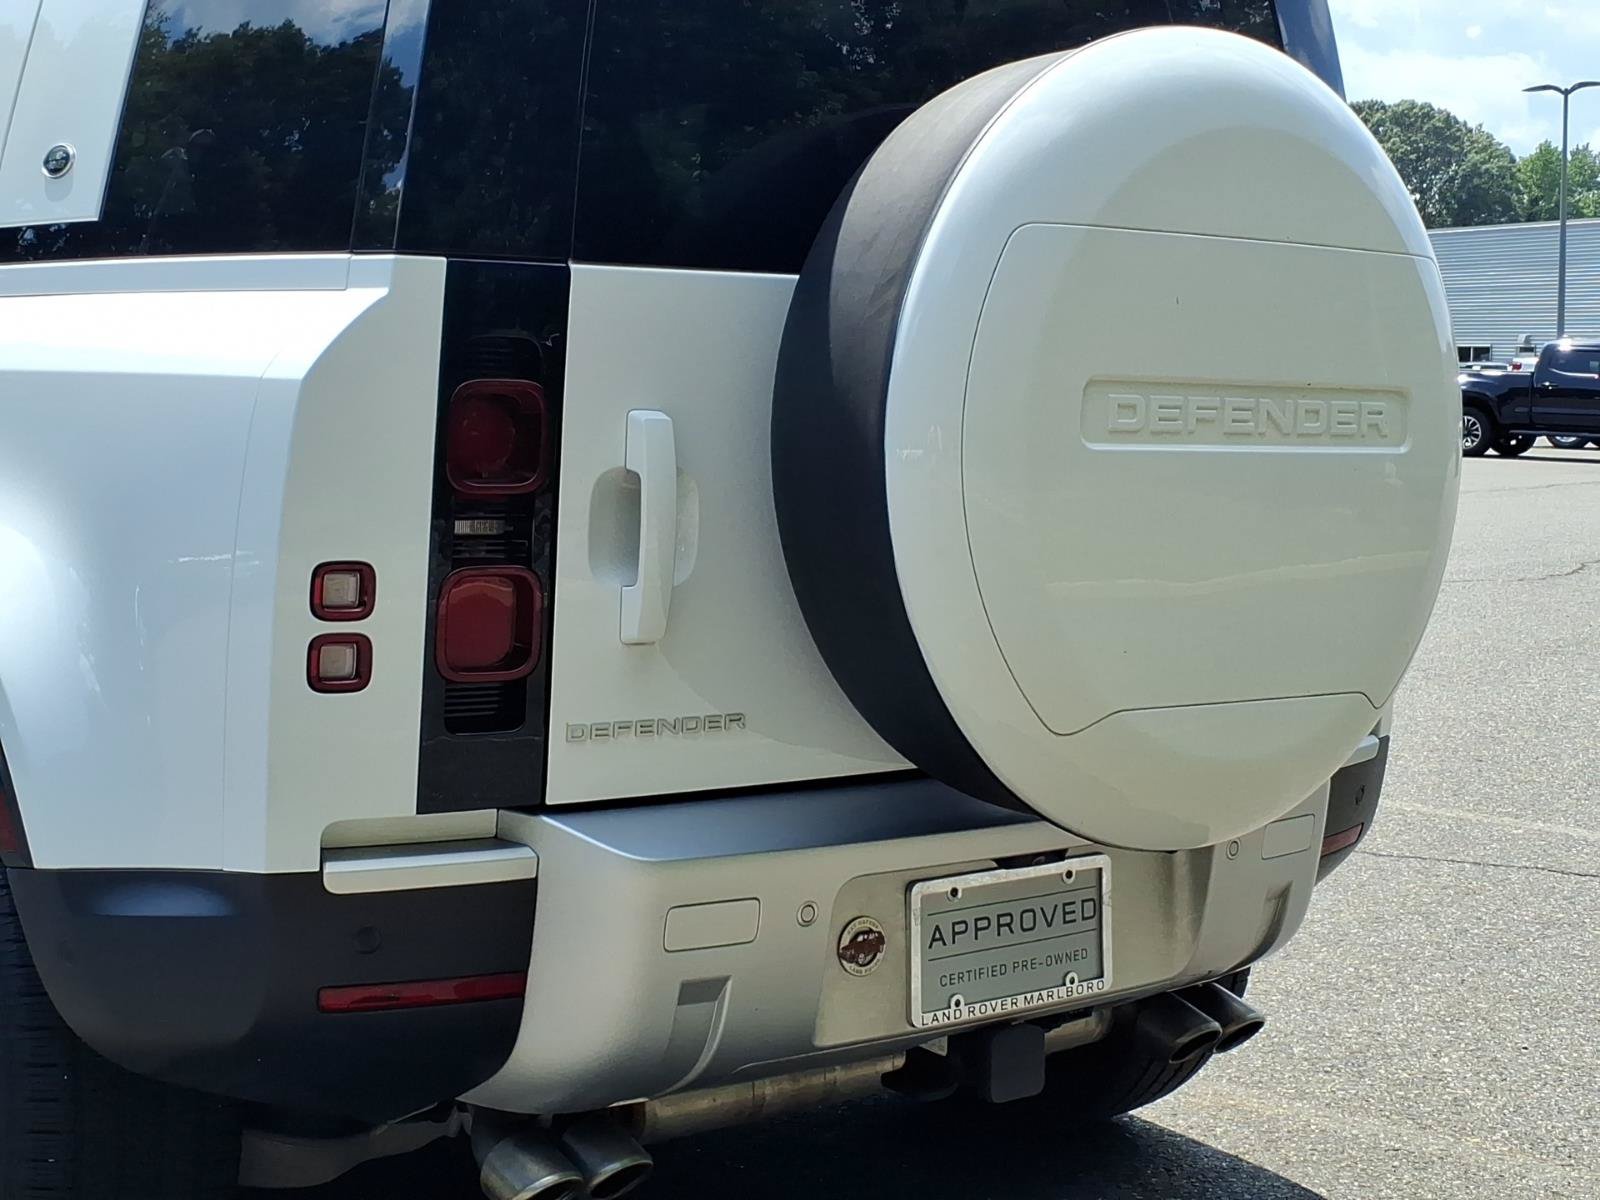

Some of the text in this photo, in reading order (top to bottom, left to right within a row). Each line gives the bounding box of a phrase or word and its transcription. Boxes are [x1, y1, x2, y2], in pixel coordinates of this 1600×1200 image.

[1107, 394, 1389, 438] DEFENDER
[565, 712, 747, 743] DEFENDER
[927, 897, 1097, 949] APPROVED
[939, 947, 1089, 988] CERTIFIED PRE-OWNED
[921, 979, 1105, 1026] LAND ROVER MARLBORO
